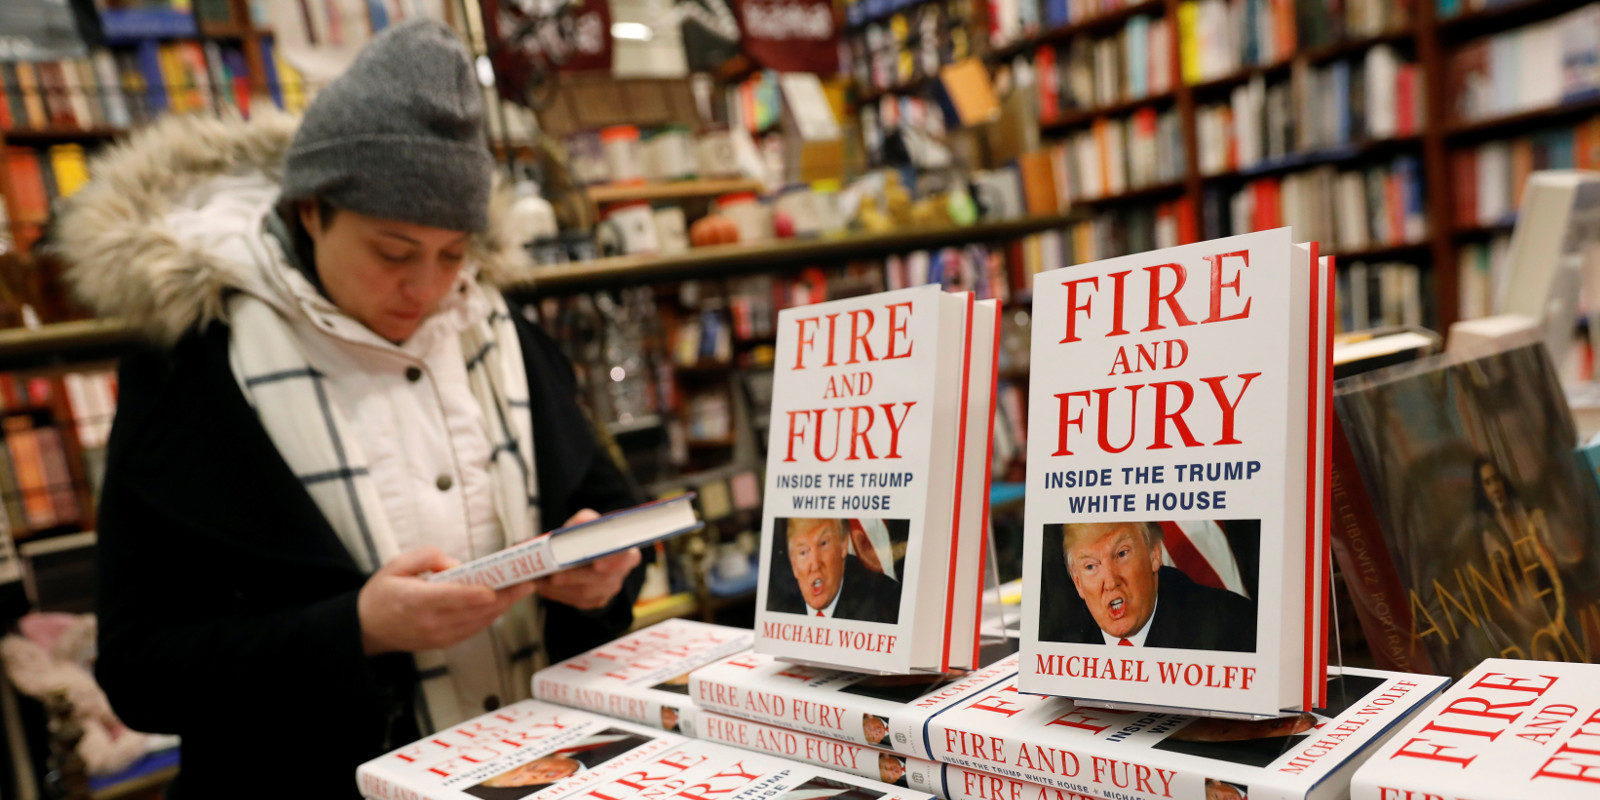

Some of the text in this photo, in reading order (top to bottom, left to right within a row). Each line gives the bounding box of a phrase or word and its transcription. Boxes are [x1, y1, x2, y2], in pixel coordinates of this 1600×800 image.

[1058, 248, 1252, 345] FIRE
[791, 300, 914, 372] FIRE
[1107, 338, 1190, 377] AND
[821, 370, 874, 400] AND
[782, 400, 919, 463] FURY
[1050, 371, 1262, 458] FURY
[776, 472, 914, 489] INSIDE THE TRUMP
[1044, 459, 1262, 490] INSIDE THE TRUMP
[792, 494, 891, 511] WHITE HOUSE
[1068, 489, 1227, 514] WHITE HOUSE
[1409, 534, 1554, 658] ANNIE
[761, 620, 898, 655] MICHAEL WOLFF
[914, 667, 1004, 709] MICHAEL
[1035, 653, 1257, 691] MICHAEL WOLFF
[537, 679, 649, 721] FIRE AND FURY
[699, 680, 847, 731] FIRE AND FURY
[1389, 672, 1560, 769] FIRE
[707, 716, 863, 771] FIRE AND FURY
[1105, 712, 1164, 743] INSIDE
[1278, 679, 1419, 776] MICHAEL WOLFF
[1515, 703, 1579, 746] AND
[586, 751, 709, 800] IRE
[666, 760, 765, 800] RY
[942, 755, 971, 767] INSIDE
[972, 761, 989, 771] THE
[991, 766, 1022, 778] TRUMP
[1024, 773, 1055, 786] WHITE
[1056, 778, 1090, 794] HOUSE
[943, 727, 1007, 764] FIRE
[1015, 742, 1081, 778] AND
[1090, 755, 1178, 799] FURY
